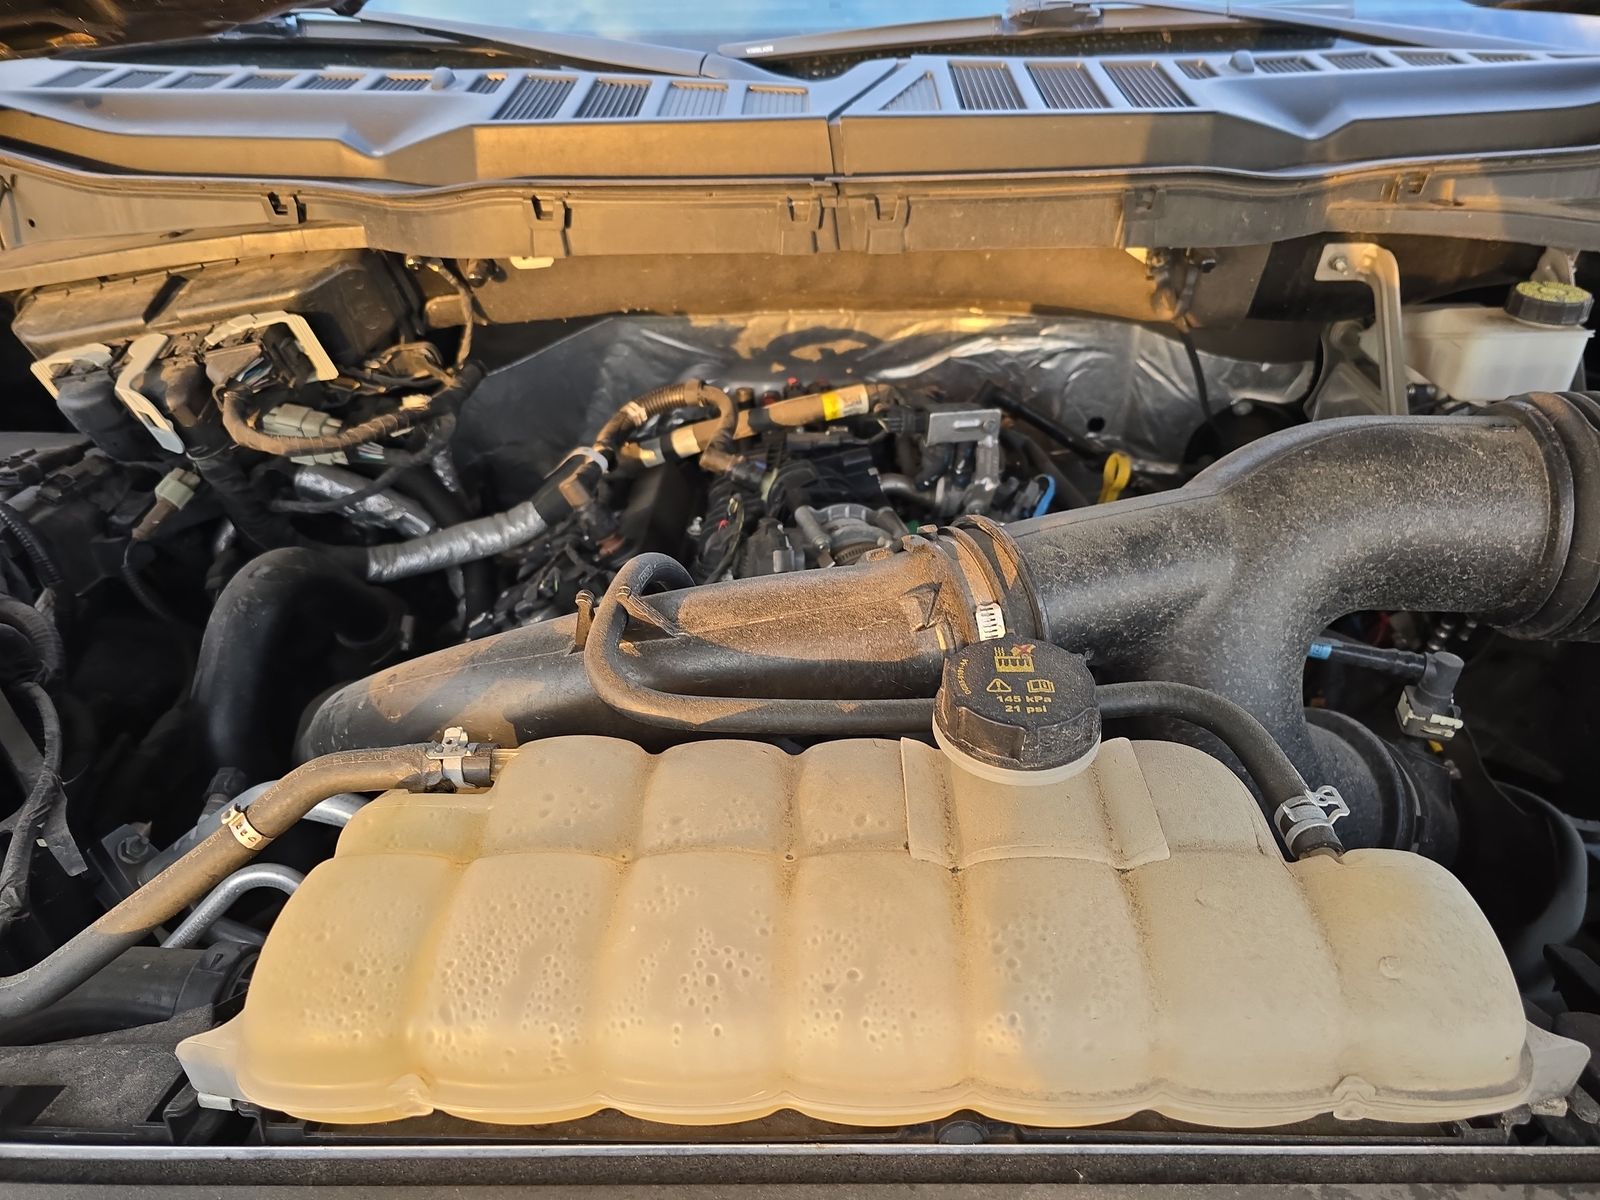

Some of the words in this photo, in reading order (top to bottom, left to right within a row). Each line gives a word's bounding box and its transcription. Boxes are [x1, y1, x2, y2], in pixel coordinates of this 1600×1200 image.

[996, 695, 1021, 703] 145
[1025, 695, 1052, 703] kPa
[1004, 705, 1021, 713] 21
[1026, 704, 1048, 714] psi
